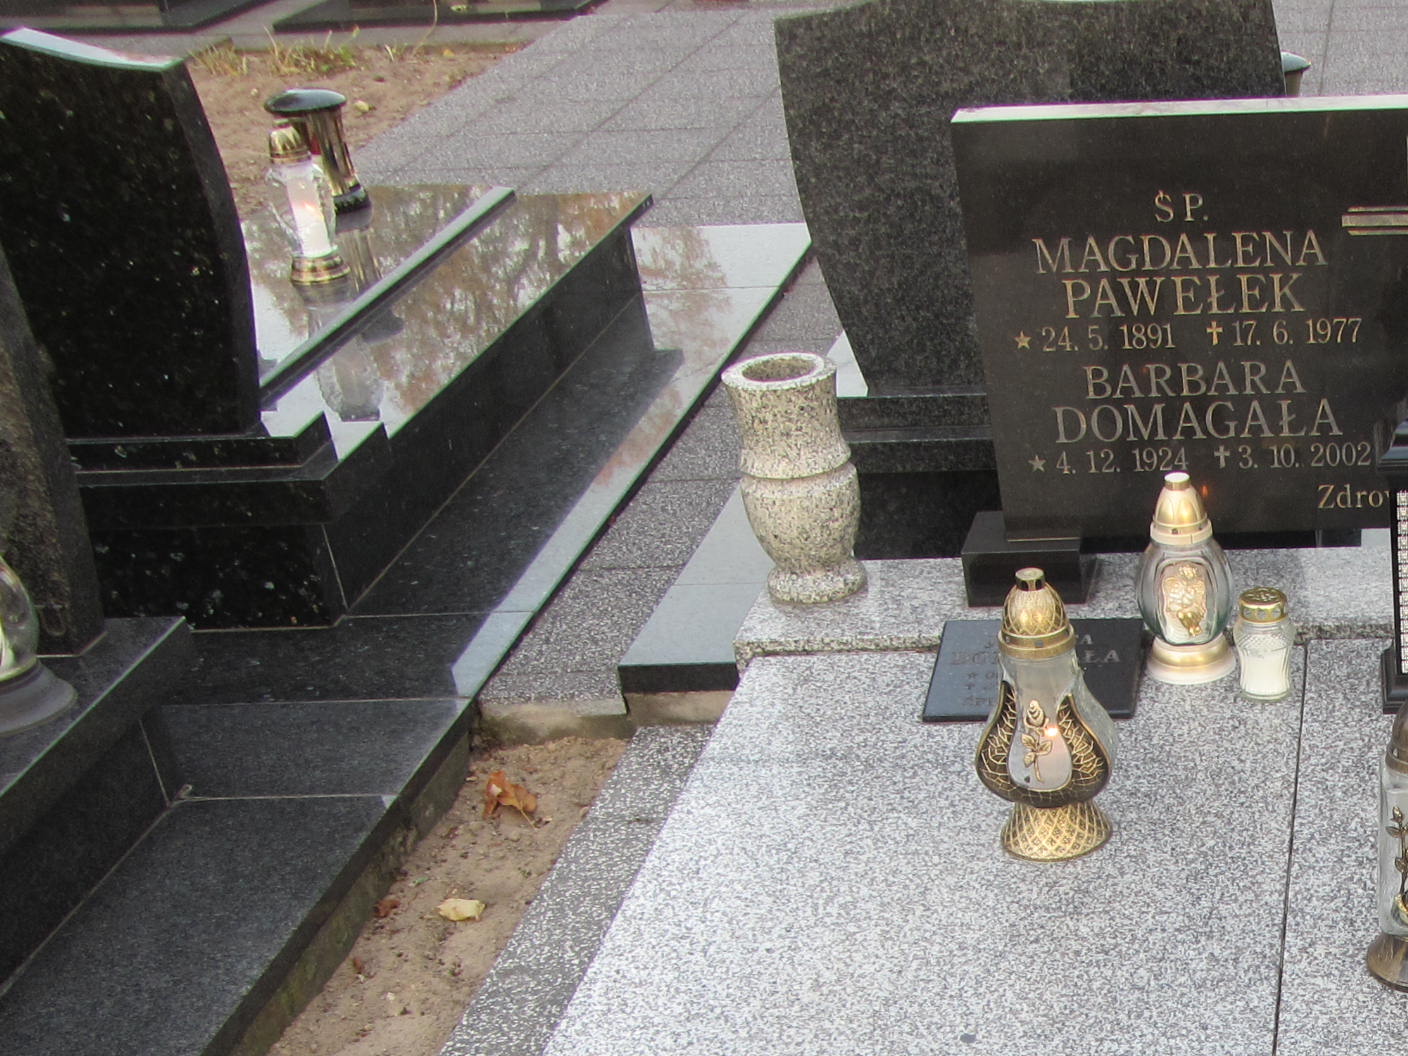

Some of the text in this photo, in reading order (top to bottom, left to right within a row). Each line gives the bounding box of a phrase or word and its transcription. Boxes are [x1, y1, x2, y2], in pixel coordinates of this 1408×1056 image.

[1032, 229, 1328, 274] MAGDALENA
[1062, 273, 1306, 318] PAWEŁEK
[1041, 318, 1362, 351] 24. 5. 1891 17. 6. 1977
[1083, 359, 1307, 399] BARBARA
[1052, 398, 1343, 443] DOMAGAŁA
[1055, 442, 1372, 475] 4. 12. 1924 3. 10. 2002
